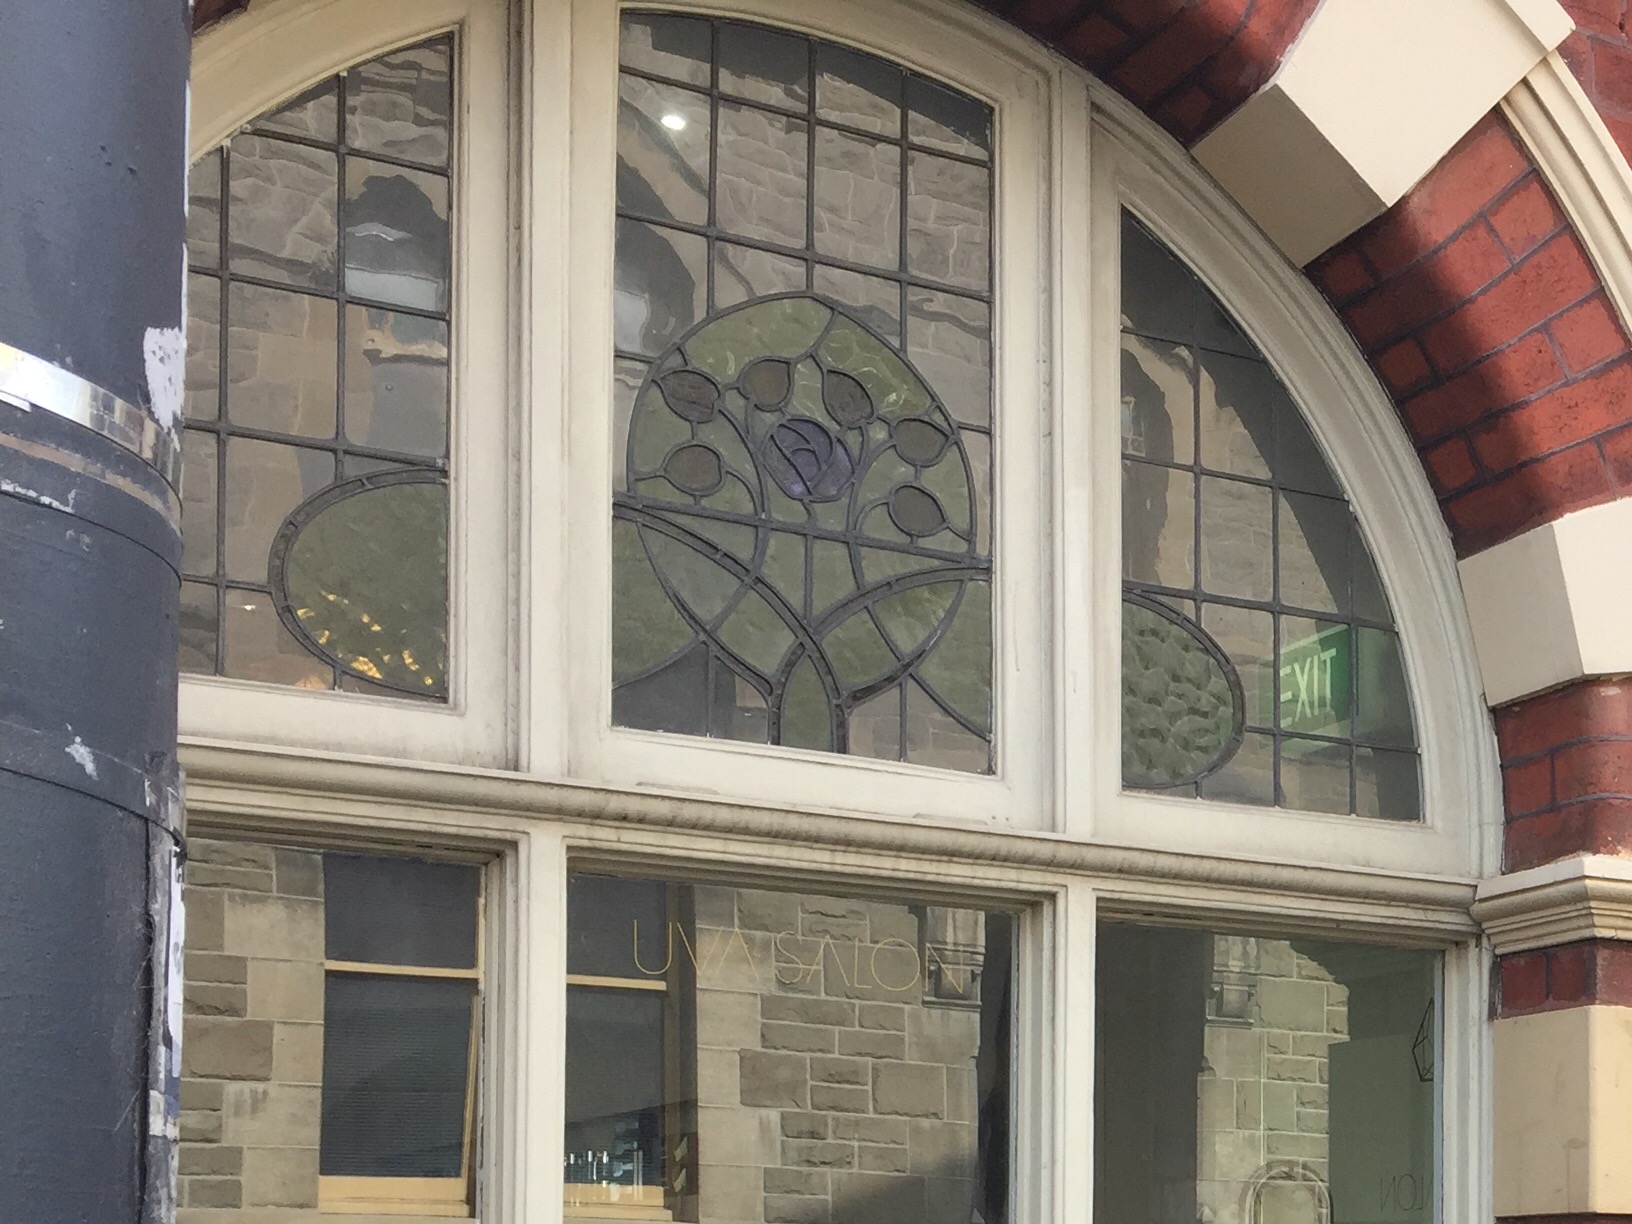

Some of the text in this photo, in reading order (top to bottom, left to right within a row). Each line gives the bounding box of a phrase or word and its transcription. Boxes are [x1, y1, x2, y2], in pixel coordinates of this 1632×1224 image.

[1279, 647, 1337, 729] EXIT
[632, 918, 965, 994] UVA SALON
